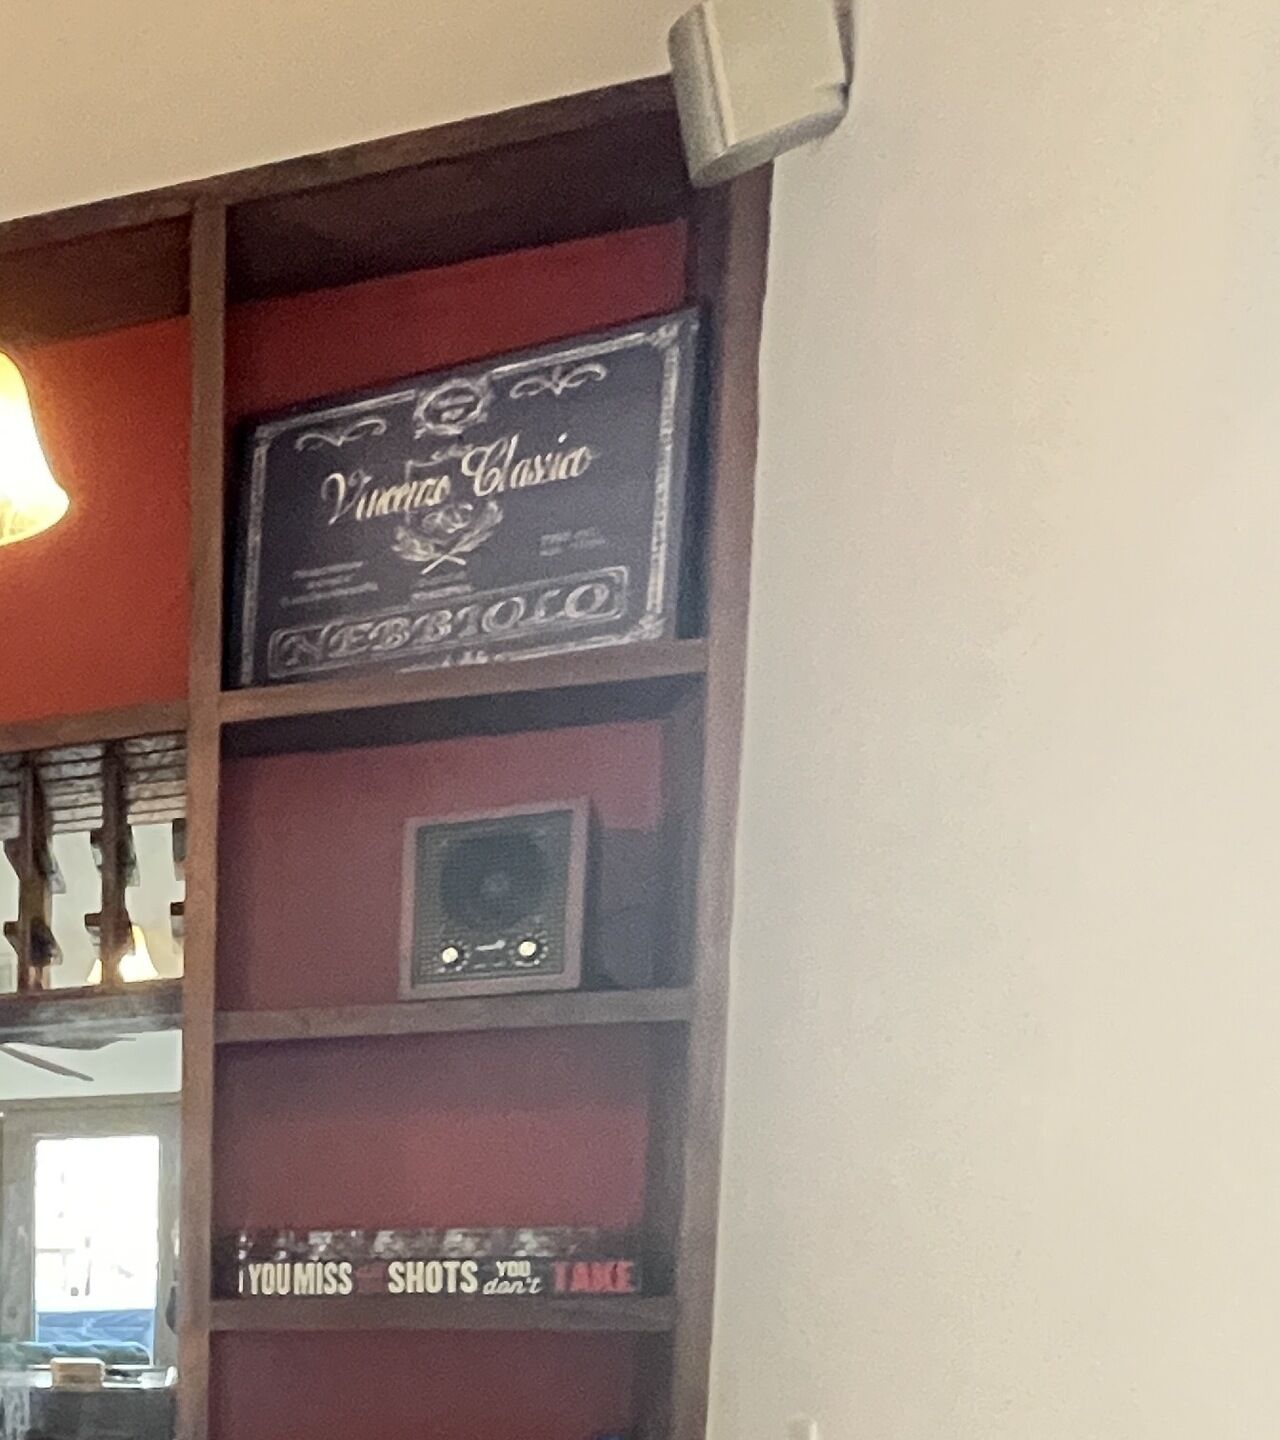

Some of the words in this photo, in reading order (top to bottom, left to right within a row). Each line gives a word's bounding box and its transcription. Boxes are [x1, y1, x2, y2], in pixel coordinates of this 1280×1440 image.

[248, 1262, 291, 1295] YOU
[293, 1261, 353, 1295] MISS
[387, 1260, 479, 1295] SHOTS
[482, 1276, 543, 1295] don't
[496, 1261, 532, 1277] YOU
